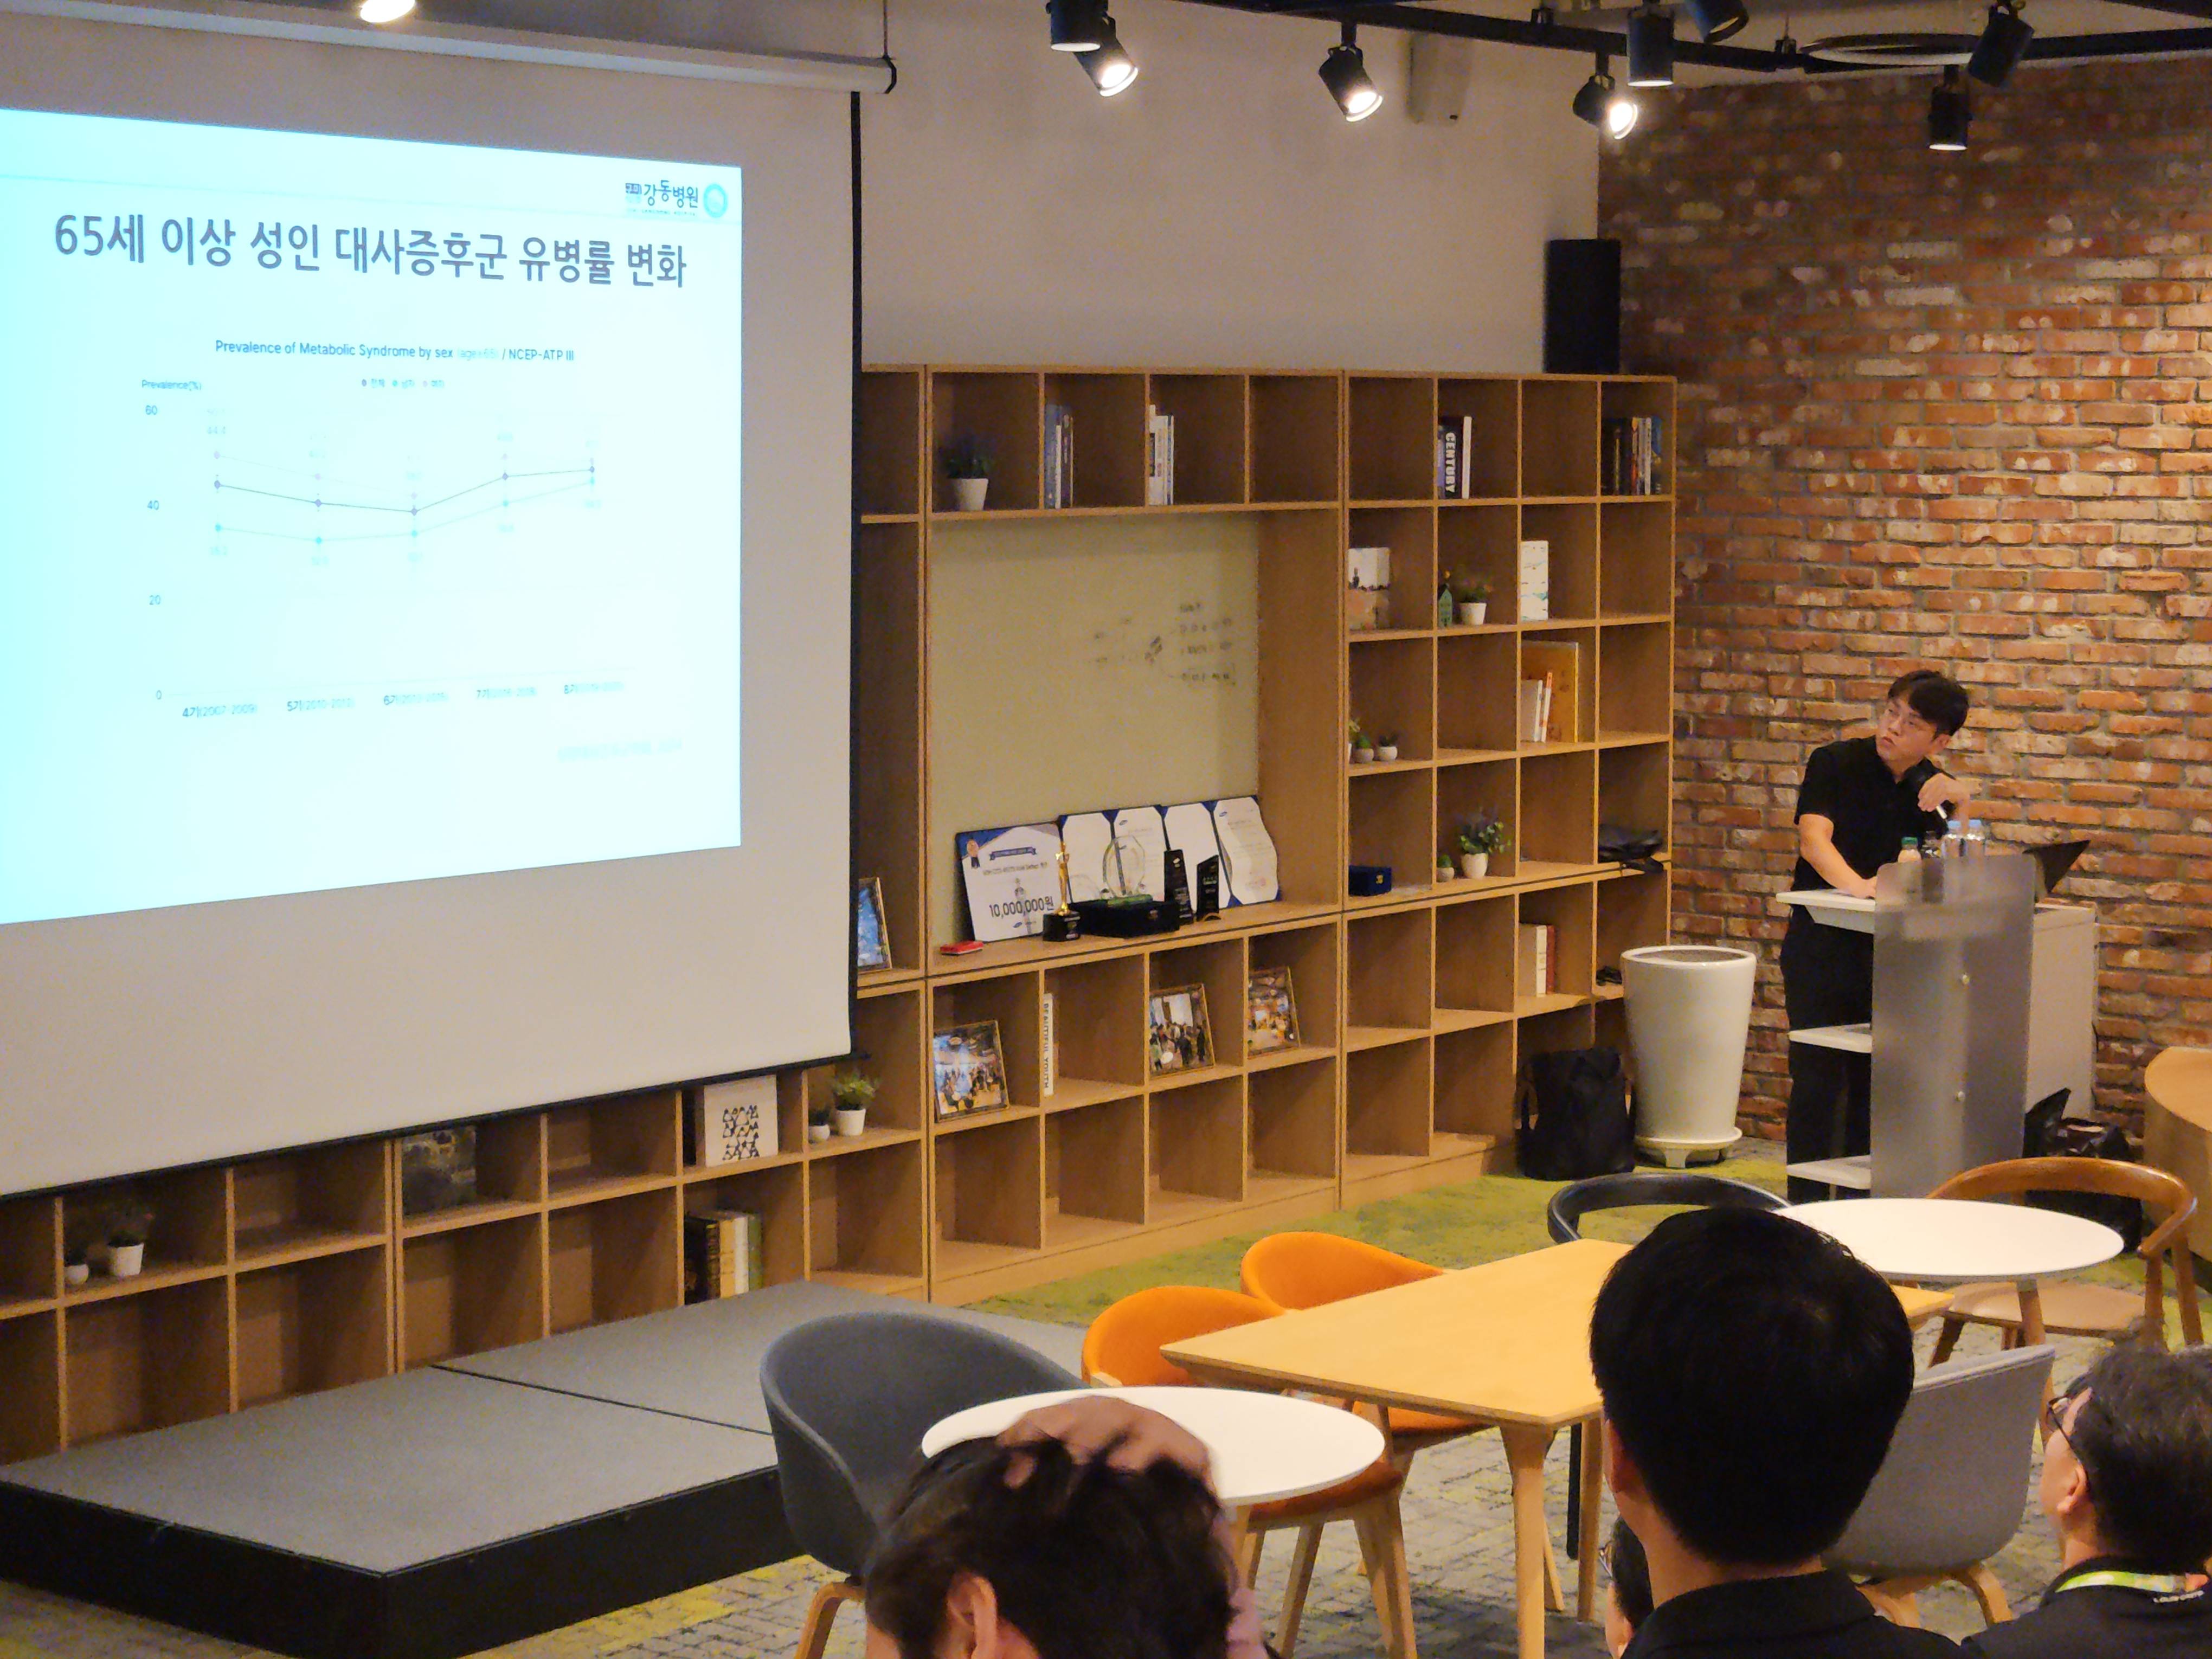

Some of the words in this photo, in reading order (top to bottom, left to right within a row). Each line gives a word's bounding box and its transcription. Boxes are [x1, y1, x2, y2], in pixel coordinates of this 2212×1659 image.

[644, 179, 698, 209] 강동병원
[55, 214, 145, 263] 65세
[161, 216, 236, 267] 이상
[250, 221, 320, 272] 성인
[335, 227, 507, 280] 대사증후군
[519, 237, 615, 285] 유병률
[628, 243, 686, 288] 변화
[215, 339, 281, 354] Prevalence
[285, 342, 296, 354] of
[299, 342, 356, 356] Metabolic
[359, 344, 415, 359] Syndrome
[419, 346, 432, 361] by
[435, 349, 454, 358] sex
[509, 349, 563, 361] NCEP-ATP
[145, 404, 158, 415] 60
[1445, 432, 1456, 493] CENTURY
[147, 500, 160, 511] 40
[149, 594, 162, 606] 20
[155, 690, 162, 700] 0
[988, 896, 1054, 920] 10,000,000원
